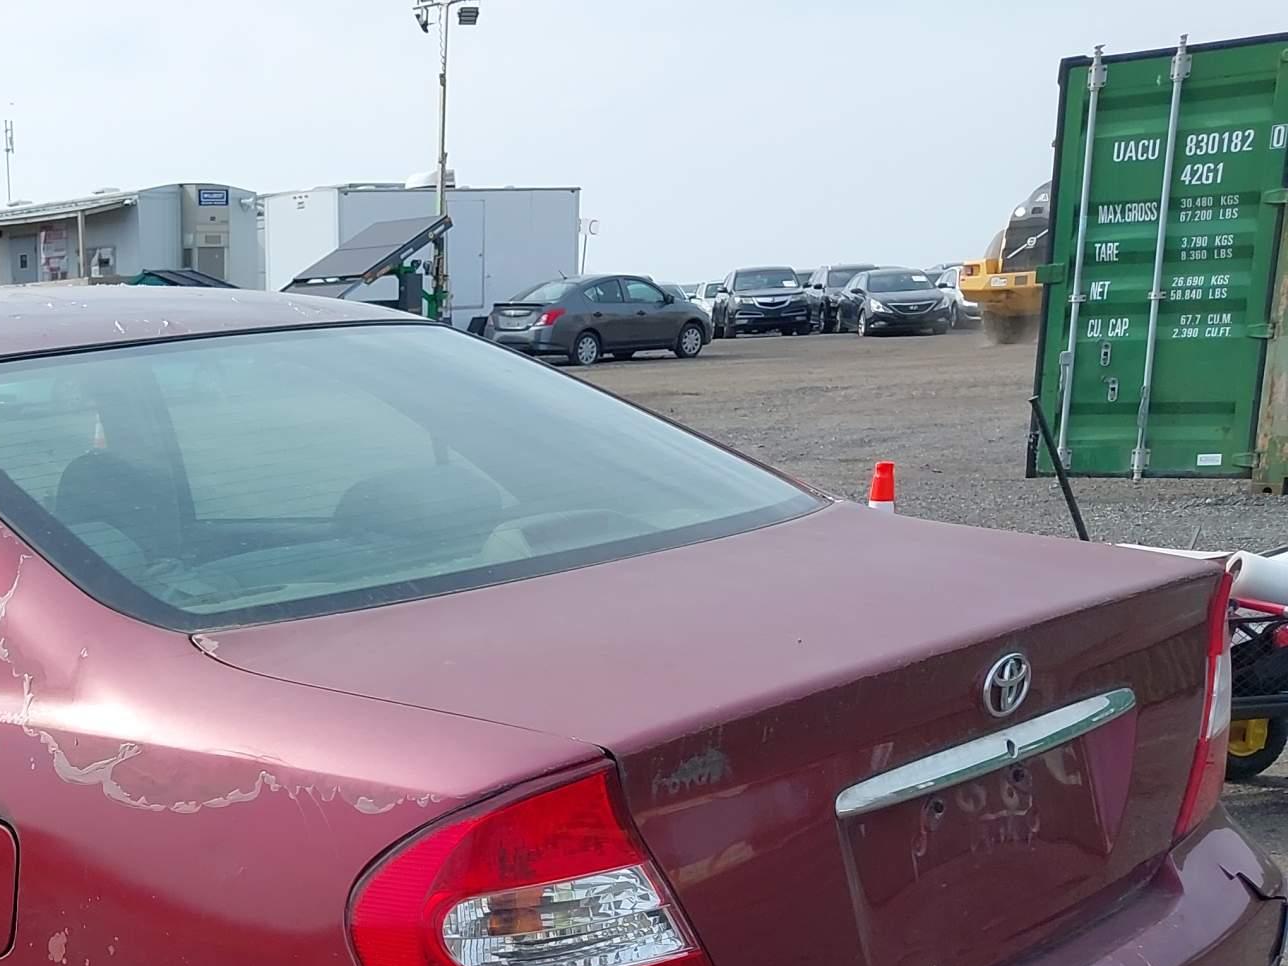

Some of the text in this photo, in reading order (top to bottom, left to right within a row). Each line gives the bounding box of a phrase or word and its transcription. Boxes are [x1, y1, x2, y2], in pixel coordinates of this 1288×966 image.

[1113, 138, 1160, 162] UACU
[1185, 129, 1255, 156] 830182
[1180, 163, 1224, 185] 42G1
[1098, 195, 1240, 224] MAX.GROSS 30.480 KGS
[1179, 208, 1239, 222] 67.200 LBS
[1094, 234, 1234, 262] TARE 3.790 KGS
[1214, 248, 1233, 259] LBS
[1089, 275, 1230, 300] NET 26.690 KGS
[1170, 288, 1228, 300] 58.840 LBS
[1087, 313, 1232, 337] CU. CAP. 67.7 CU.M.
[1171, 326, 1231, 338] 2.390 CU.FT.
